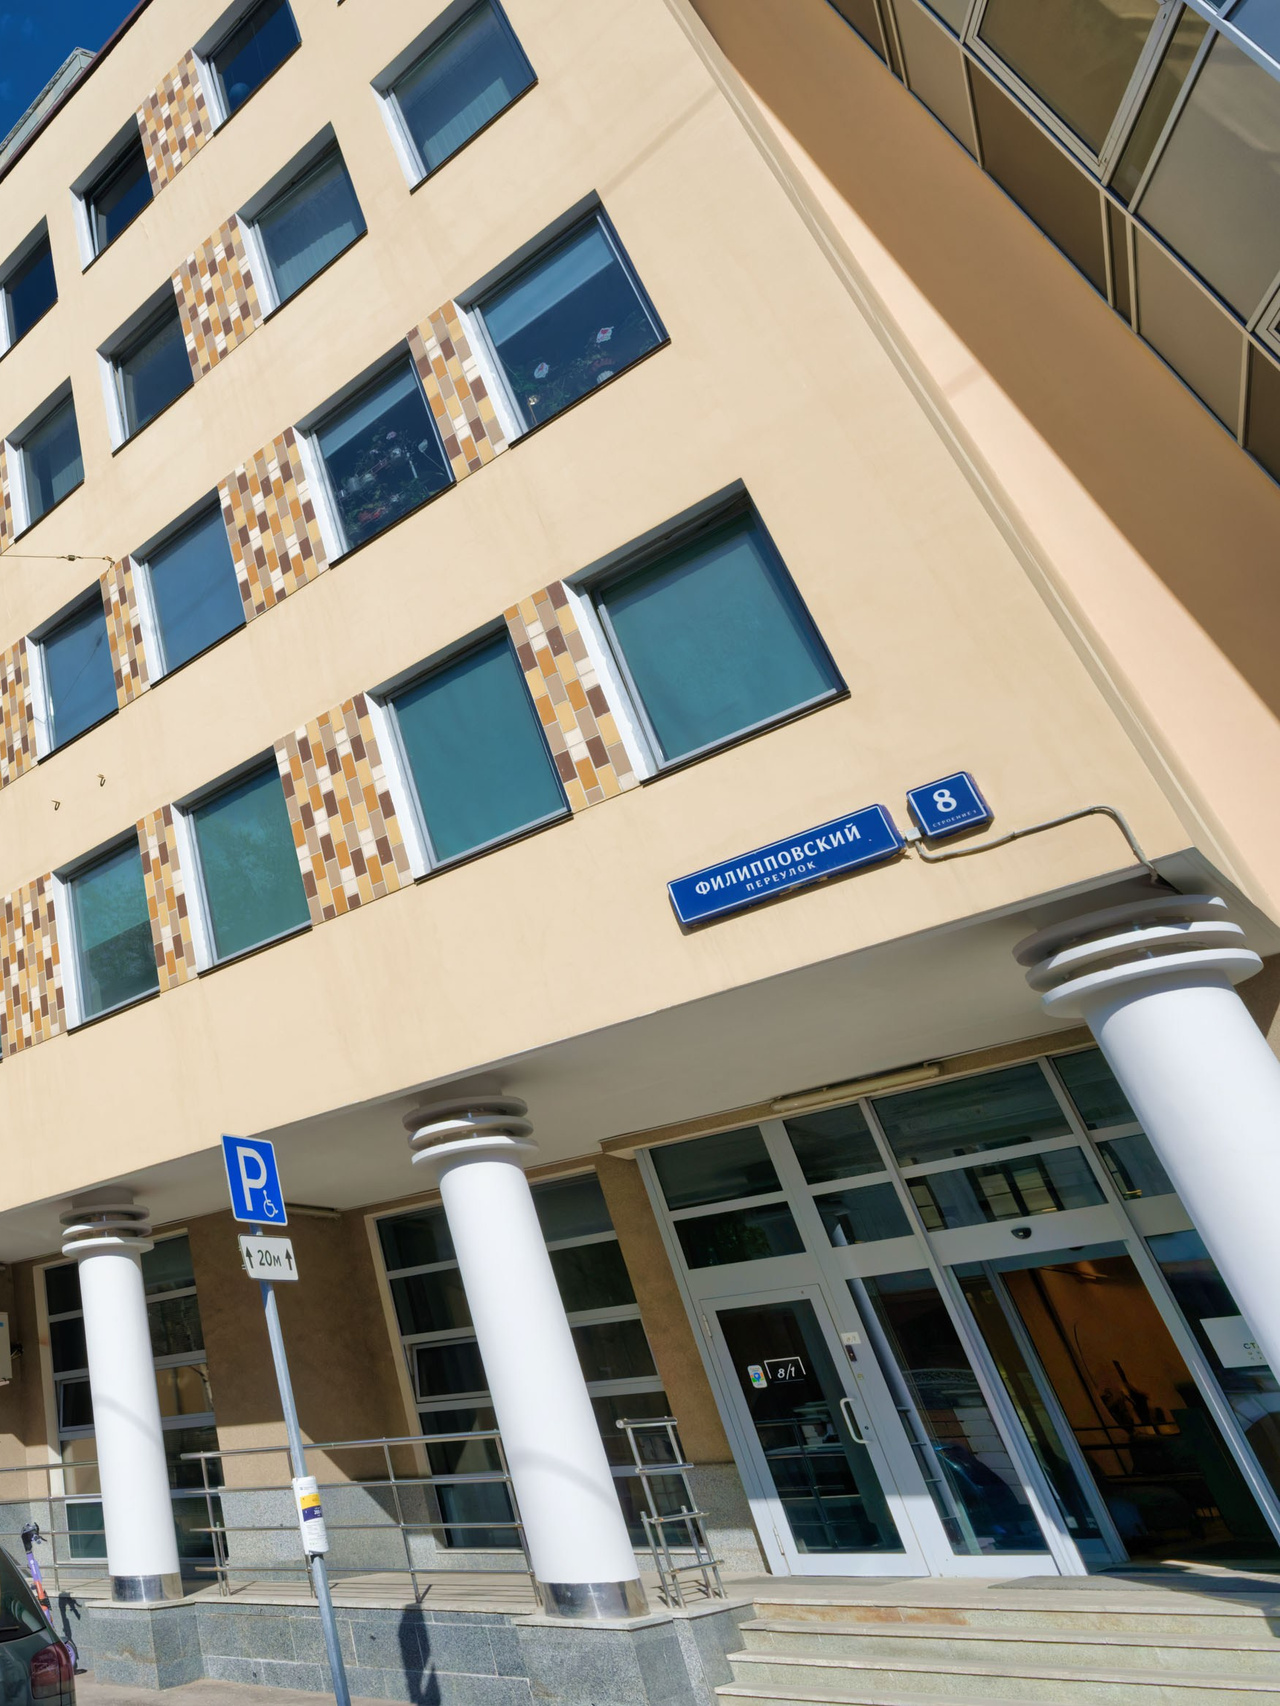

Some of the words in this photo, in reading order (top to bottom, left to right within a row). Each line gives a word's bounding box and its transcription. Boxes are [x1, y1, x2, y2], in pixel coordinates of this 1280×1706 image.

[932, 789, 958, 813] 8
[932, 811, 972, 828] СТРОЕНИЕ
[695, 823, 861, 895] ФИЛИППОВСКИЙ
[746, 861, 816, 892] ПЕРЕУЛОК
[236, 1146, 268, 1212] P
[777, 1363, 796, 1380] 8/1
